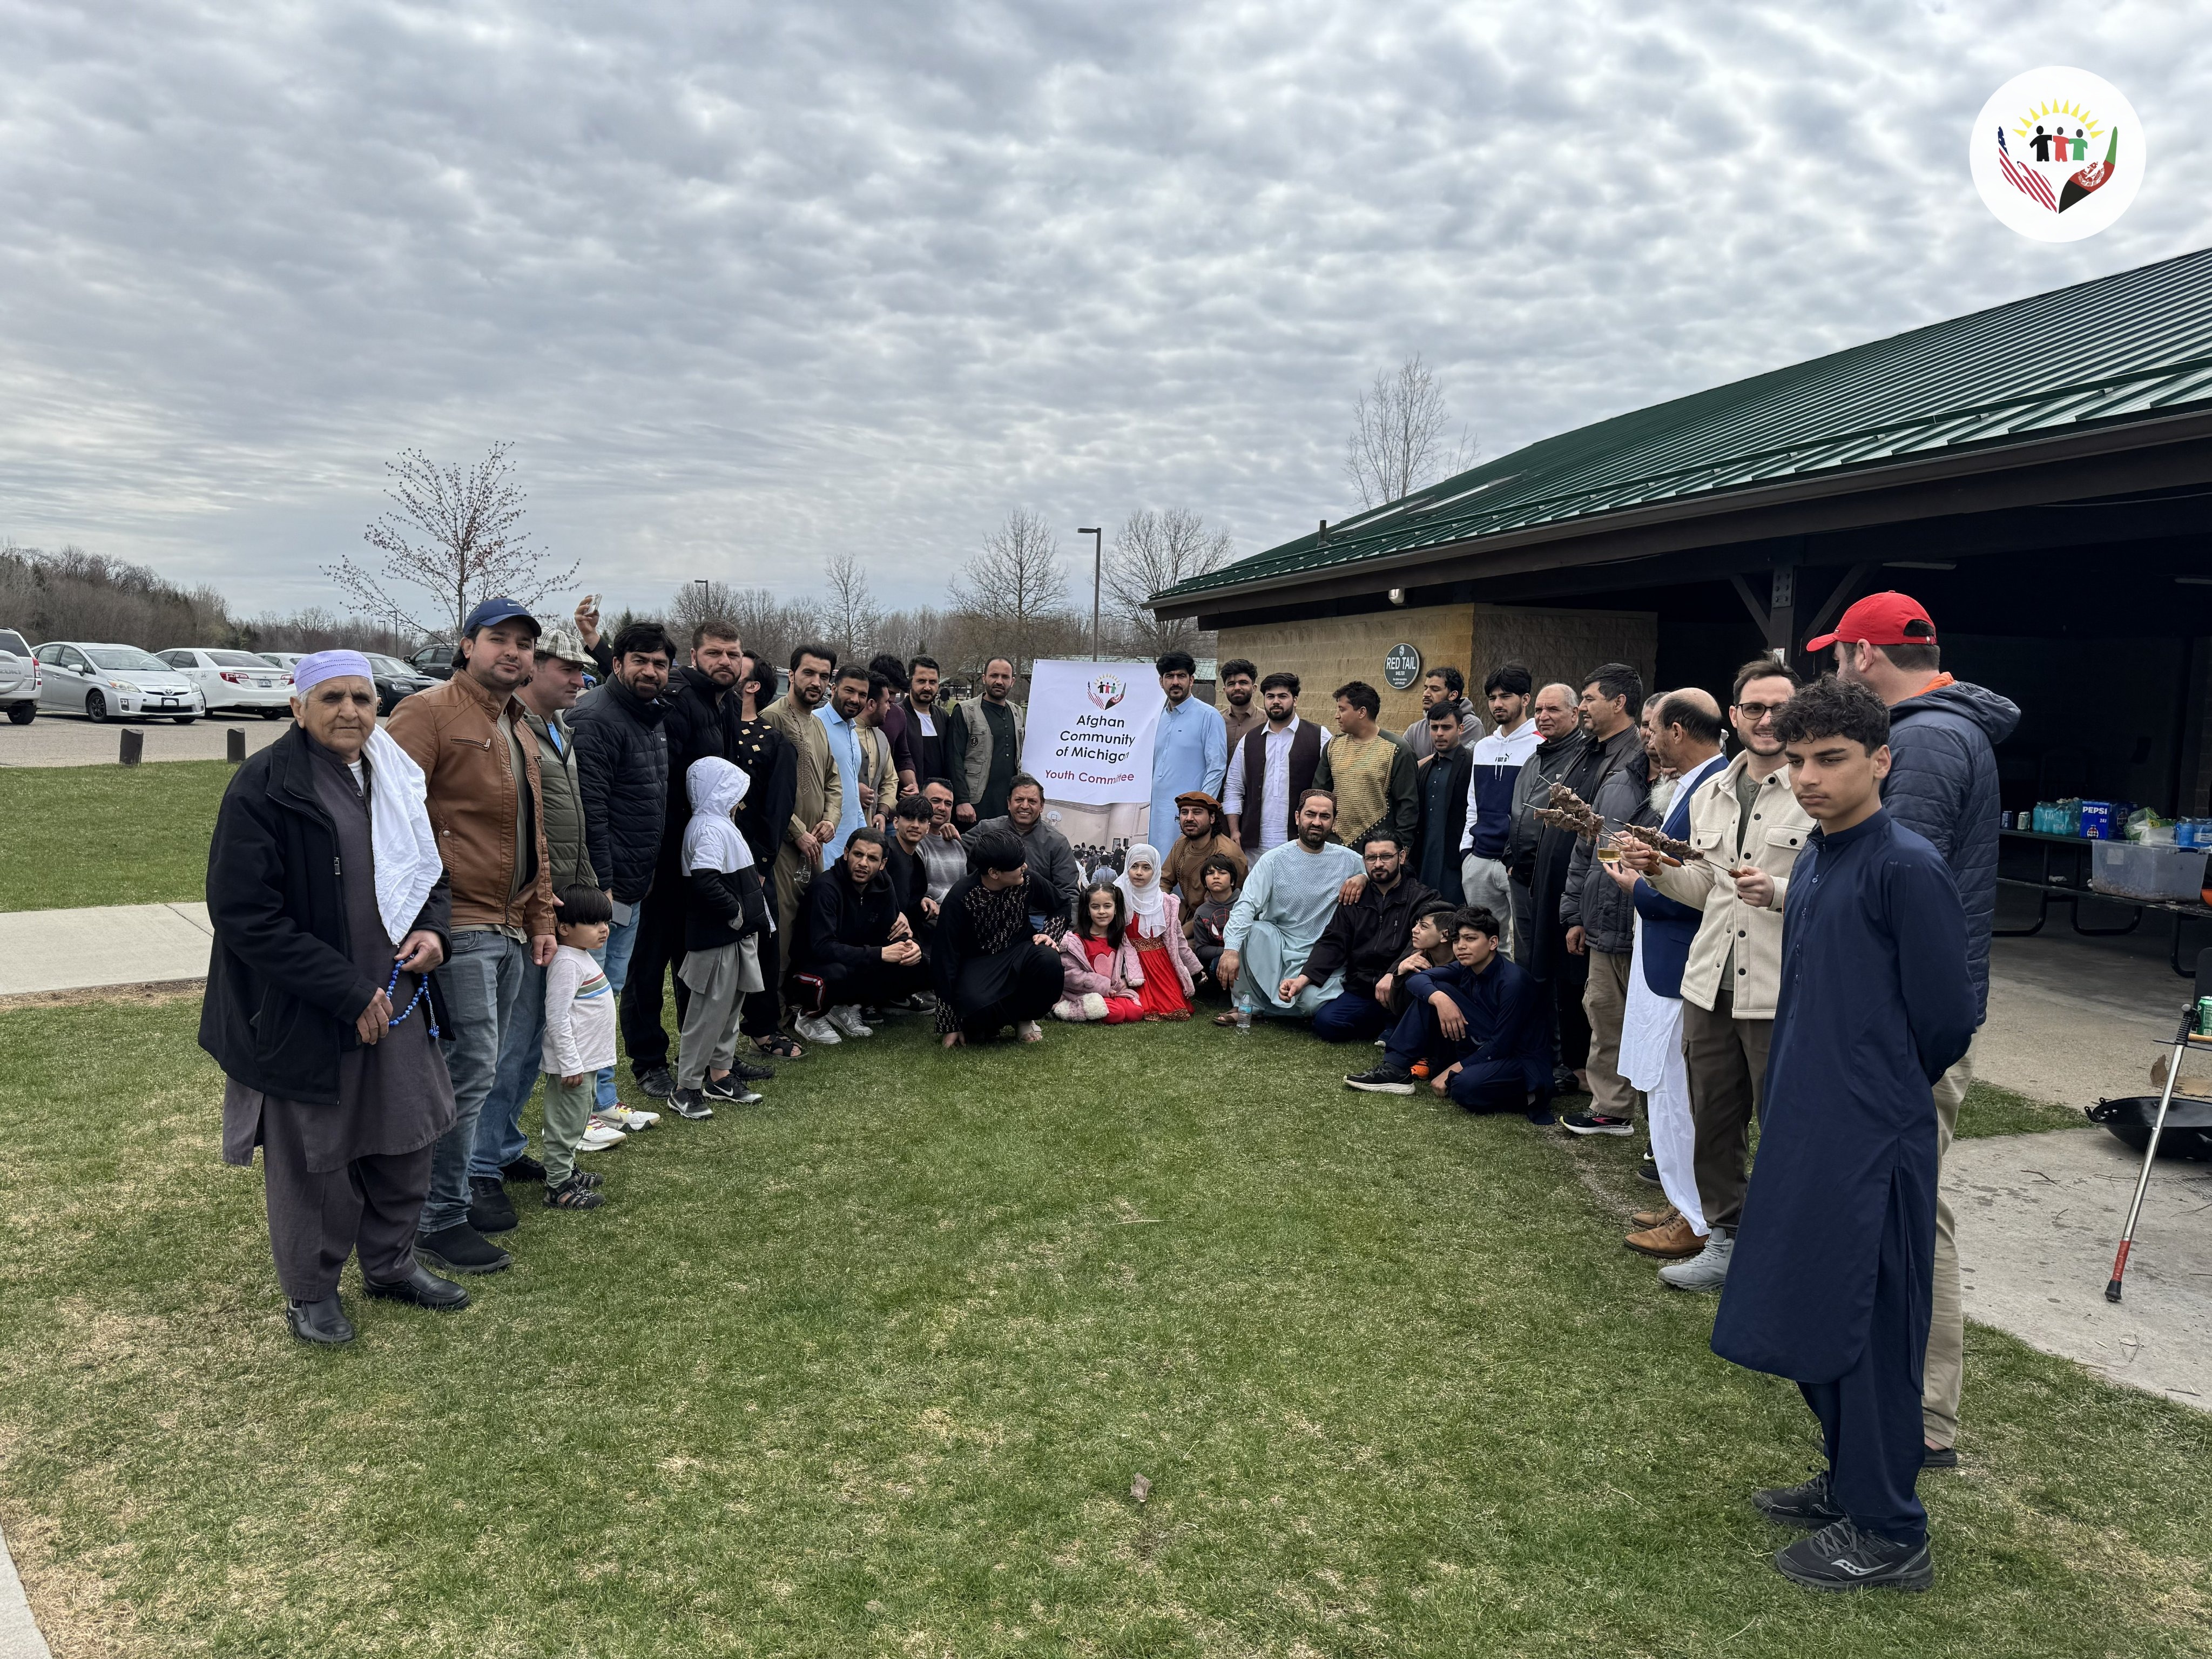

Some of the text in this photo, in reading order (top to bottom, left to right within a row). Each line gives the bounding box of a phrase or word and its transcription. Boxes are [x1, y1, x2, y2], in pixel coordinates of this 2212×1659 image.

[1386, 657, 1416, 670] RED TAIL
[1076, 715, 1124, 728] Afghan
[1060, 731, 1135, 747] Community
[1056, 746, 1069, 757] of
[1046, 770, 1134, 785] Youth Committee
[2082, 806, 2108, 815] PEPSI
